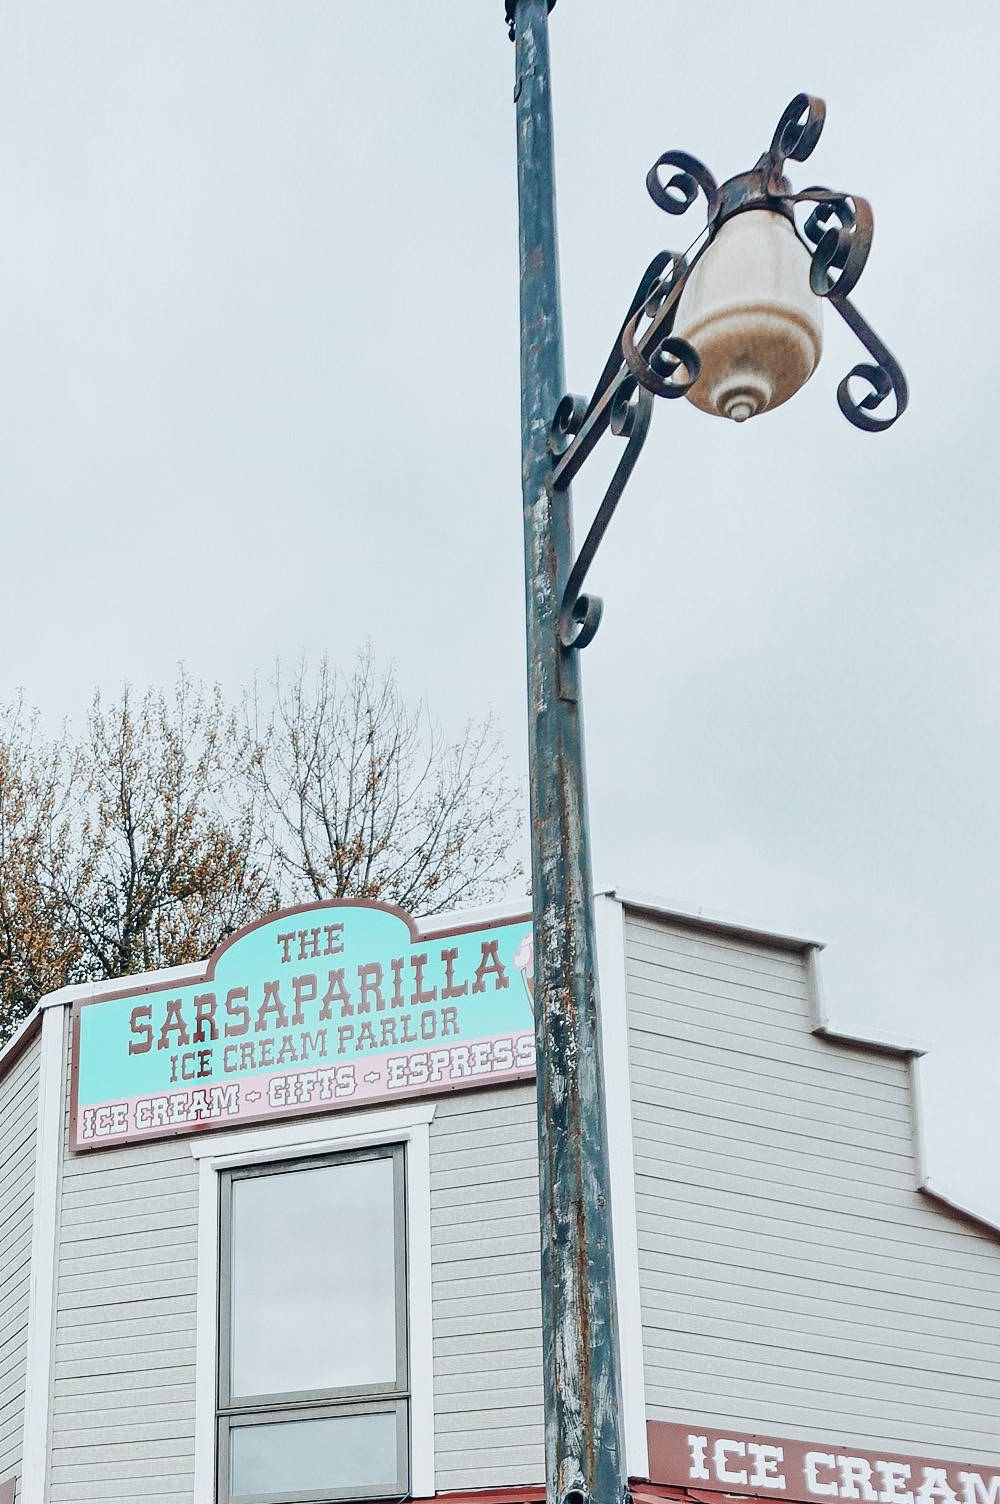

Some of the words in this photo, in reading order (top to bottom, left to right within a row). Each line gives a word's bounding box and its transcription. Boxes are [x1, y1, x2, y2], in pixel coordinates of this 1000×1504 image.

[277, 923, 344, 963] THE
[128, 940, 509, 1056] SARSAPARILLA
[170, 1050, 213, 1083] ICE
[223, 1028, 328, 1073] CREAM
[337, 1006, 460, 1054] PARLOR
[83, 1103, 129, 1139] ICE
[133, 1083, 240, 1129] CREAM
[267, 1065, 357, 1108] GIFTS
[687, 1434, 787, 1490] ICE
